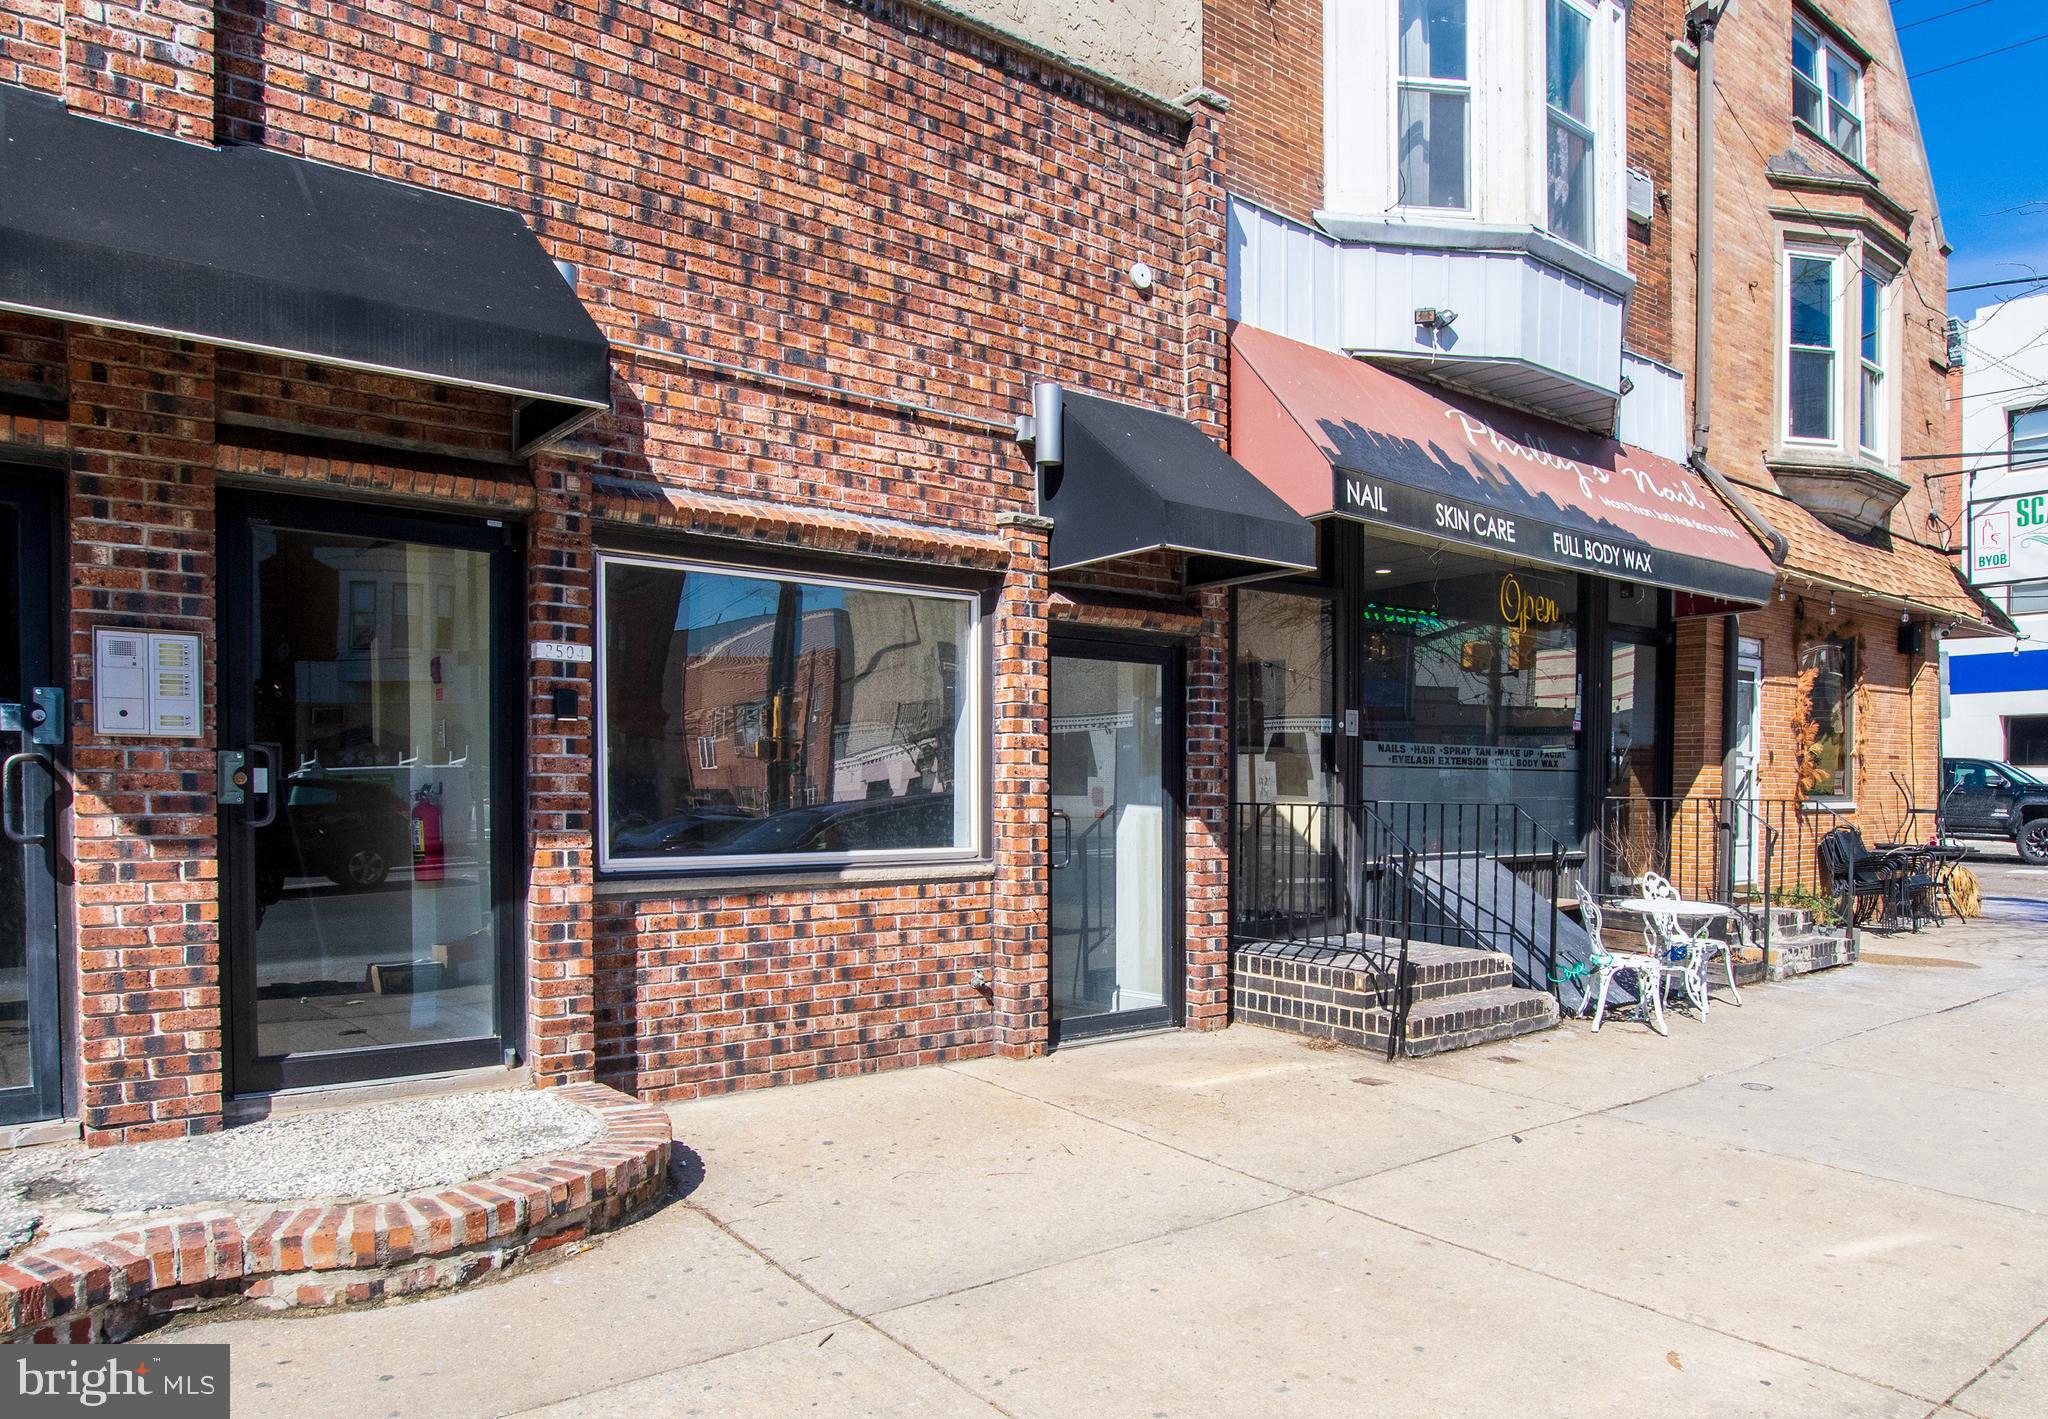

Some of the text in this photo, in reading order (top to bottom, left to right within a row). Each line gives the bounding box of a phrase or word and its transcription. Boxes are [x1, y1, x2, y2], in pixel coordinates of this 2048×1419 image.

[1346, 479, 1388, 512] NAIL
[1621, 467, 1706, 510] Nail
[1435, 503, 1516, 543] SKIN CARE
[2017, 496, 2048, 527] SC
[1553, 531, 1652, 573] FULL BODY WAX
[1978, 553, 2007, 567] BYOB
[1500, 573, 1559, 633] Open
[546, 644, 584, 660] 2504
[1377, 743, 1406, 753] NAILS
[1414, 745, 1436, 754] HAIR
[1443, 746, 1471, 756] SPRAY
[1475, 747, 1491, 756] TAN
[1498, 748, 1520, 757] MAKE
[1523, 749, 1534, 758] UP
[1391, 755, 1435, 765] EYELASH
[1438, 756, 1488, 766] EXTENSION
[1516, 759, 1538, 767] BODY
[1541, 759, 1559, 768] WAX
